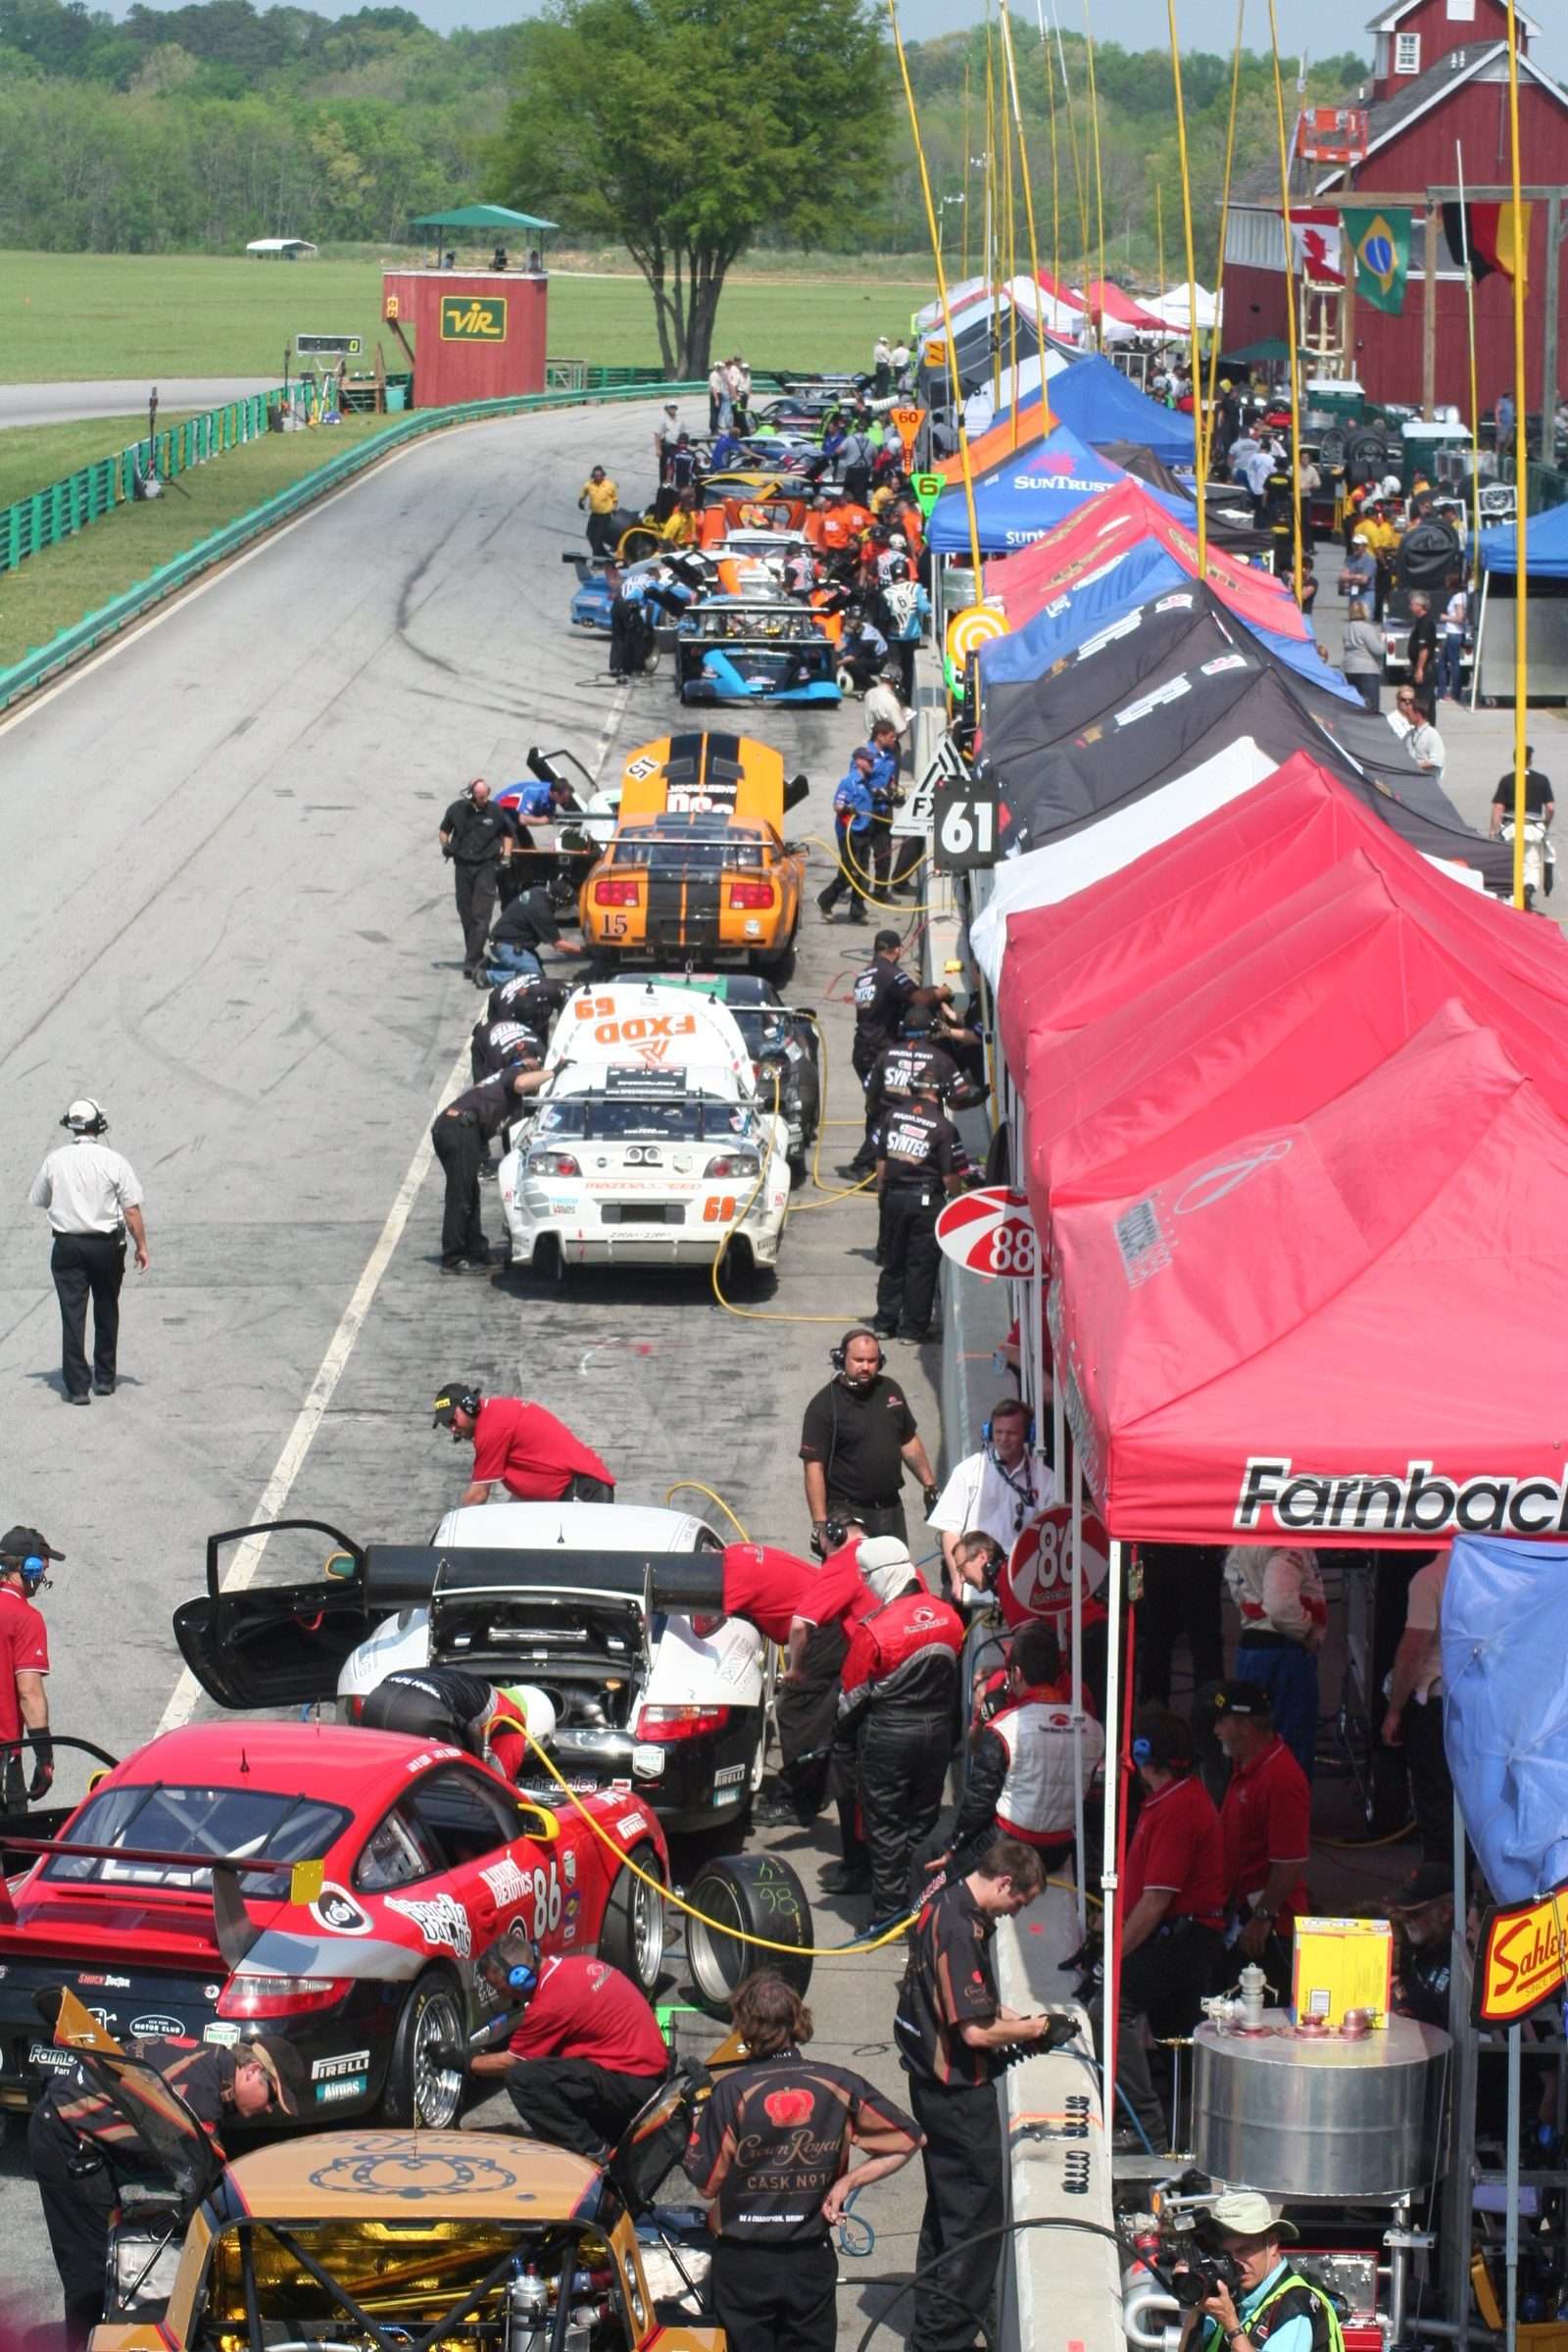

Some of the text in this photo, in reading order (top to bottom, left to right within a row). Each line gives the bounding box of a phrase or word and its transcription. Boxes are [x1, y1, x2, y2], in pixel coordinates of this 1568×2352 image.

[898, 412, 918, 423] 60
[918, 476, 939, 496] 6
[897, 595, 907, 609] 6
[628, 758, 659, 779] 15
[941, 802, 993, 854] 61
[601, 913, 628, 936] 15
[574, 996, 616, 1020] 69
[594, 1015, 697, 1045] FXDD
[886, 1130, 931, 1158] SYNTEC
[702, 1195, 736, 1223] 69
[989, 1226, 1036, 1272] 88
[713, 1763, 746, 1788] PIRELLI
[533, 1860, 563, 1939] 86
[161, 2025, 180, 2034] CLUB
[312, 2049, 370, 2080] PIRELLI
[735, 2129, 842, 2168] Crown Royal
[747, 2176, 791, 2189] CASK
